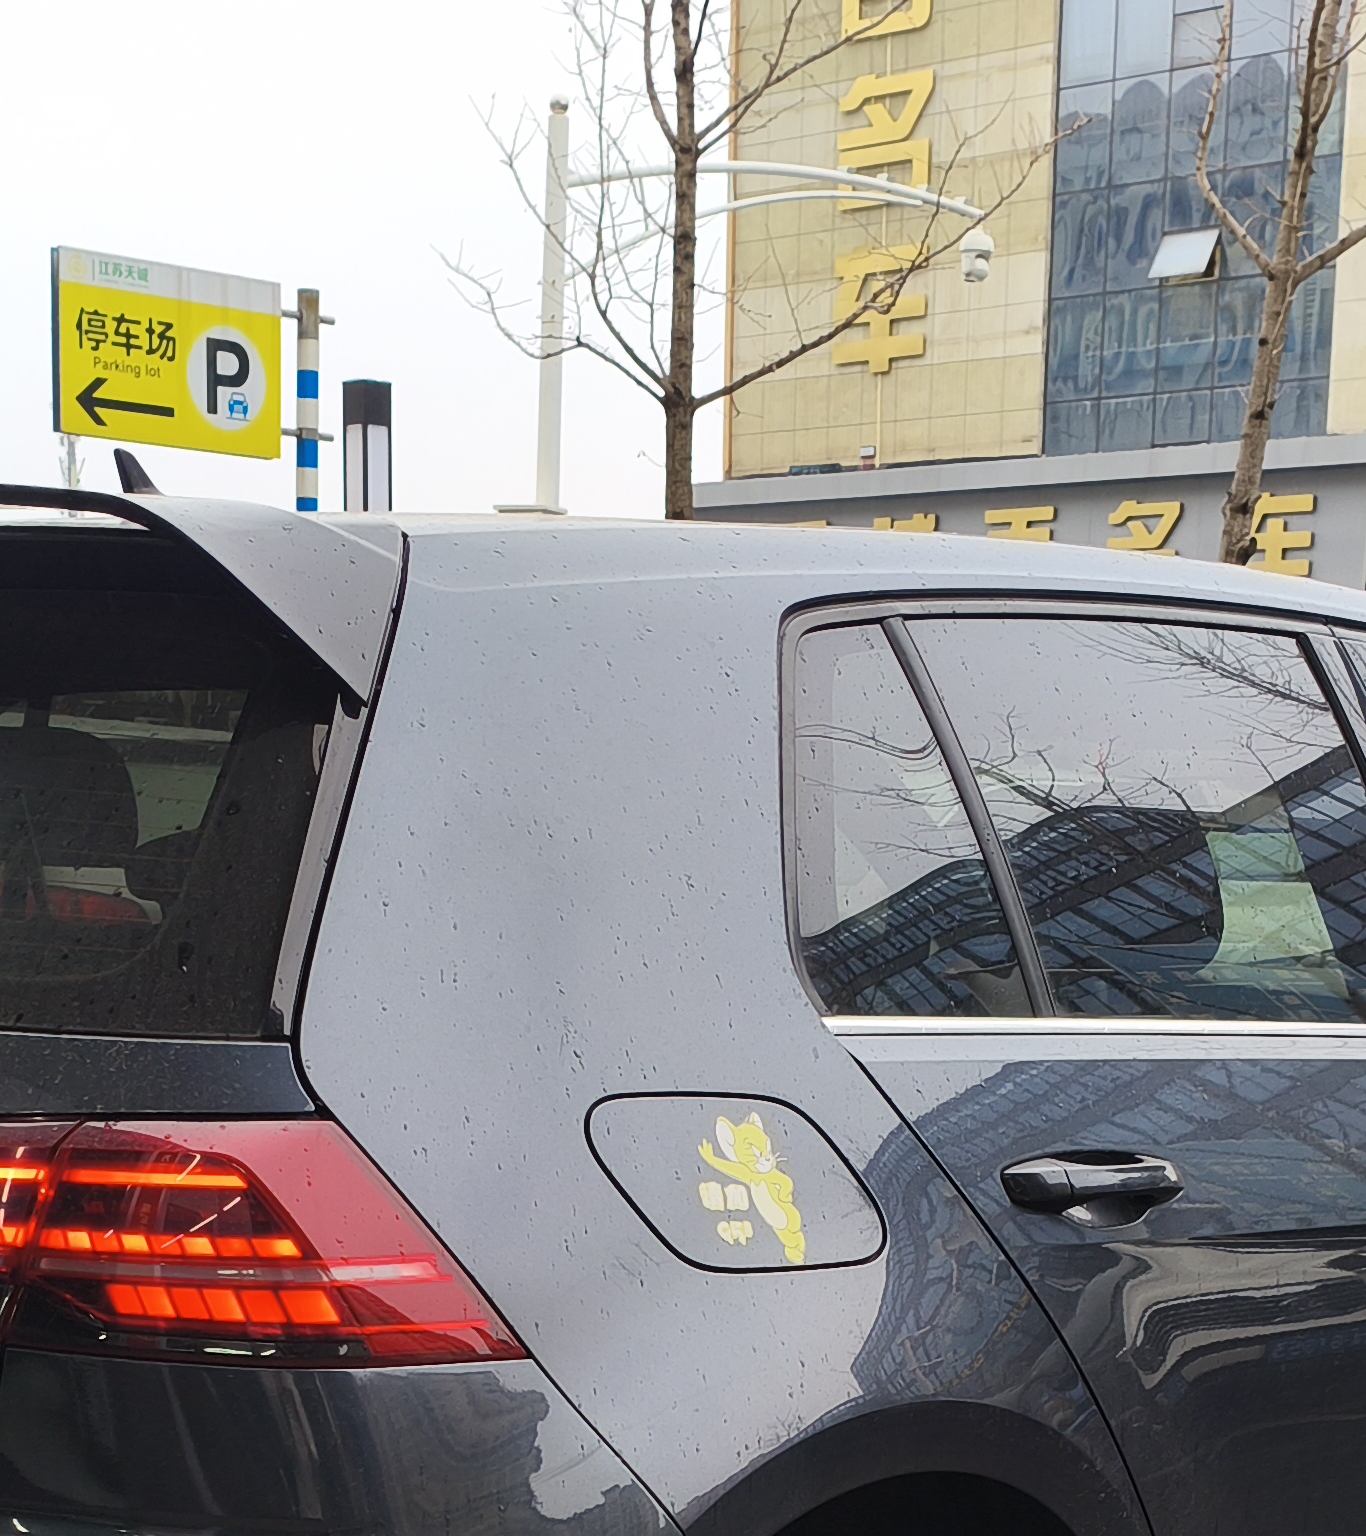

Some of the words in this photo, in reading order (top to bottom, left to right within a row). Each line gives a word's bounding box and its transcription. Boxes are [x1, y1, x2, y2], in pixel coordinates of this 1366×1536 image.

[76, 306, 177, 362] 停车场
[93, 356, 141, 378] Parking
[145, 363, 161, 378] lot
